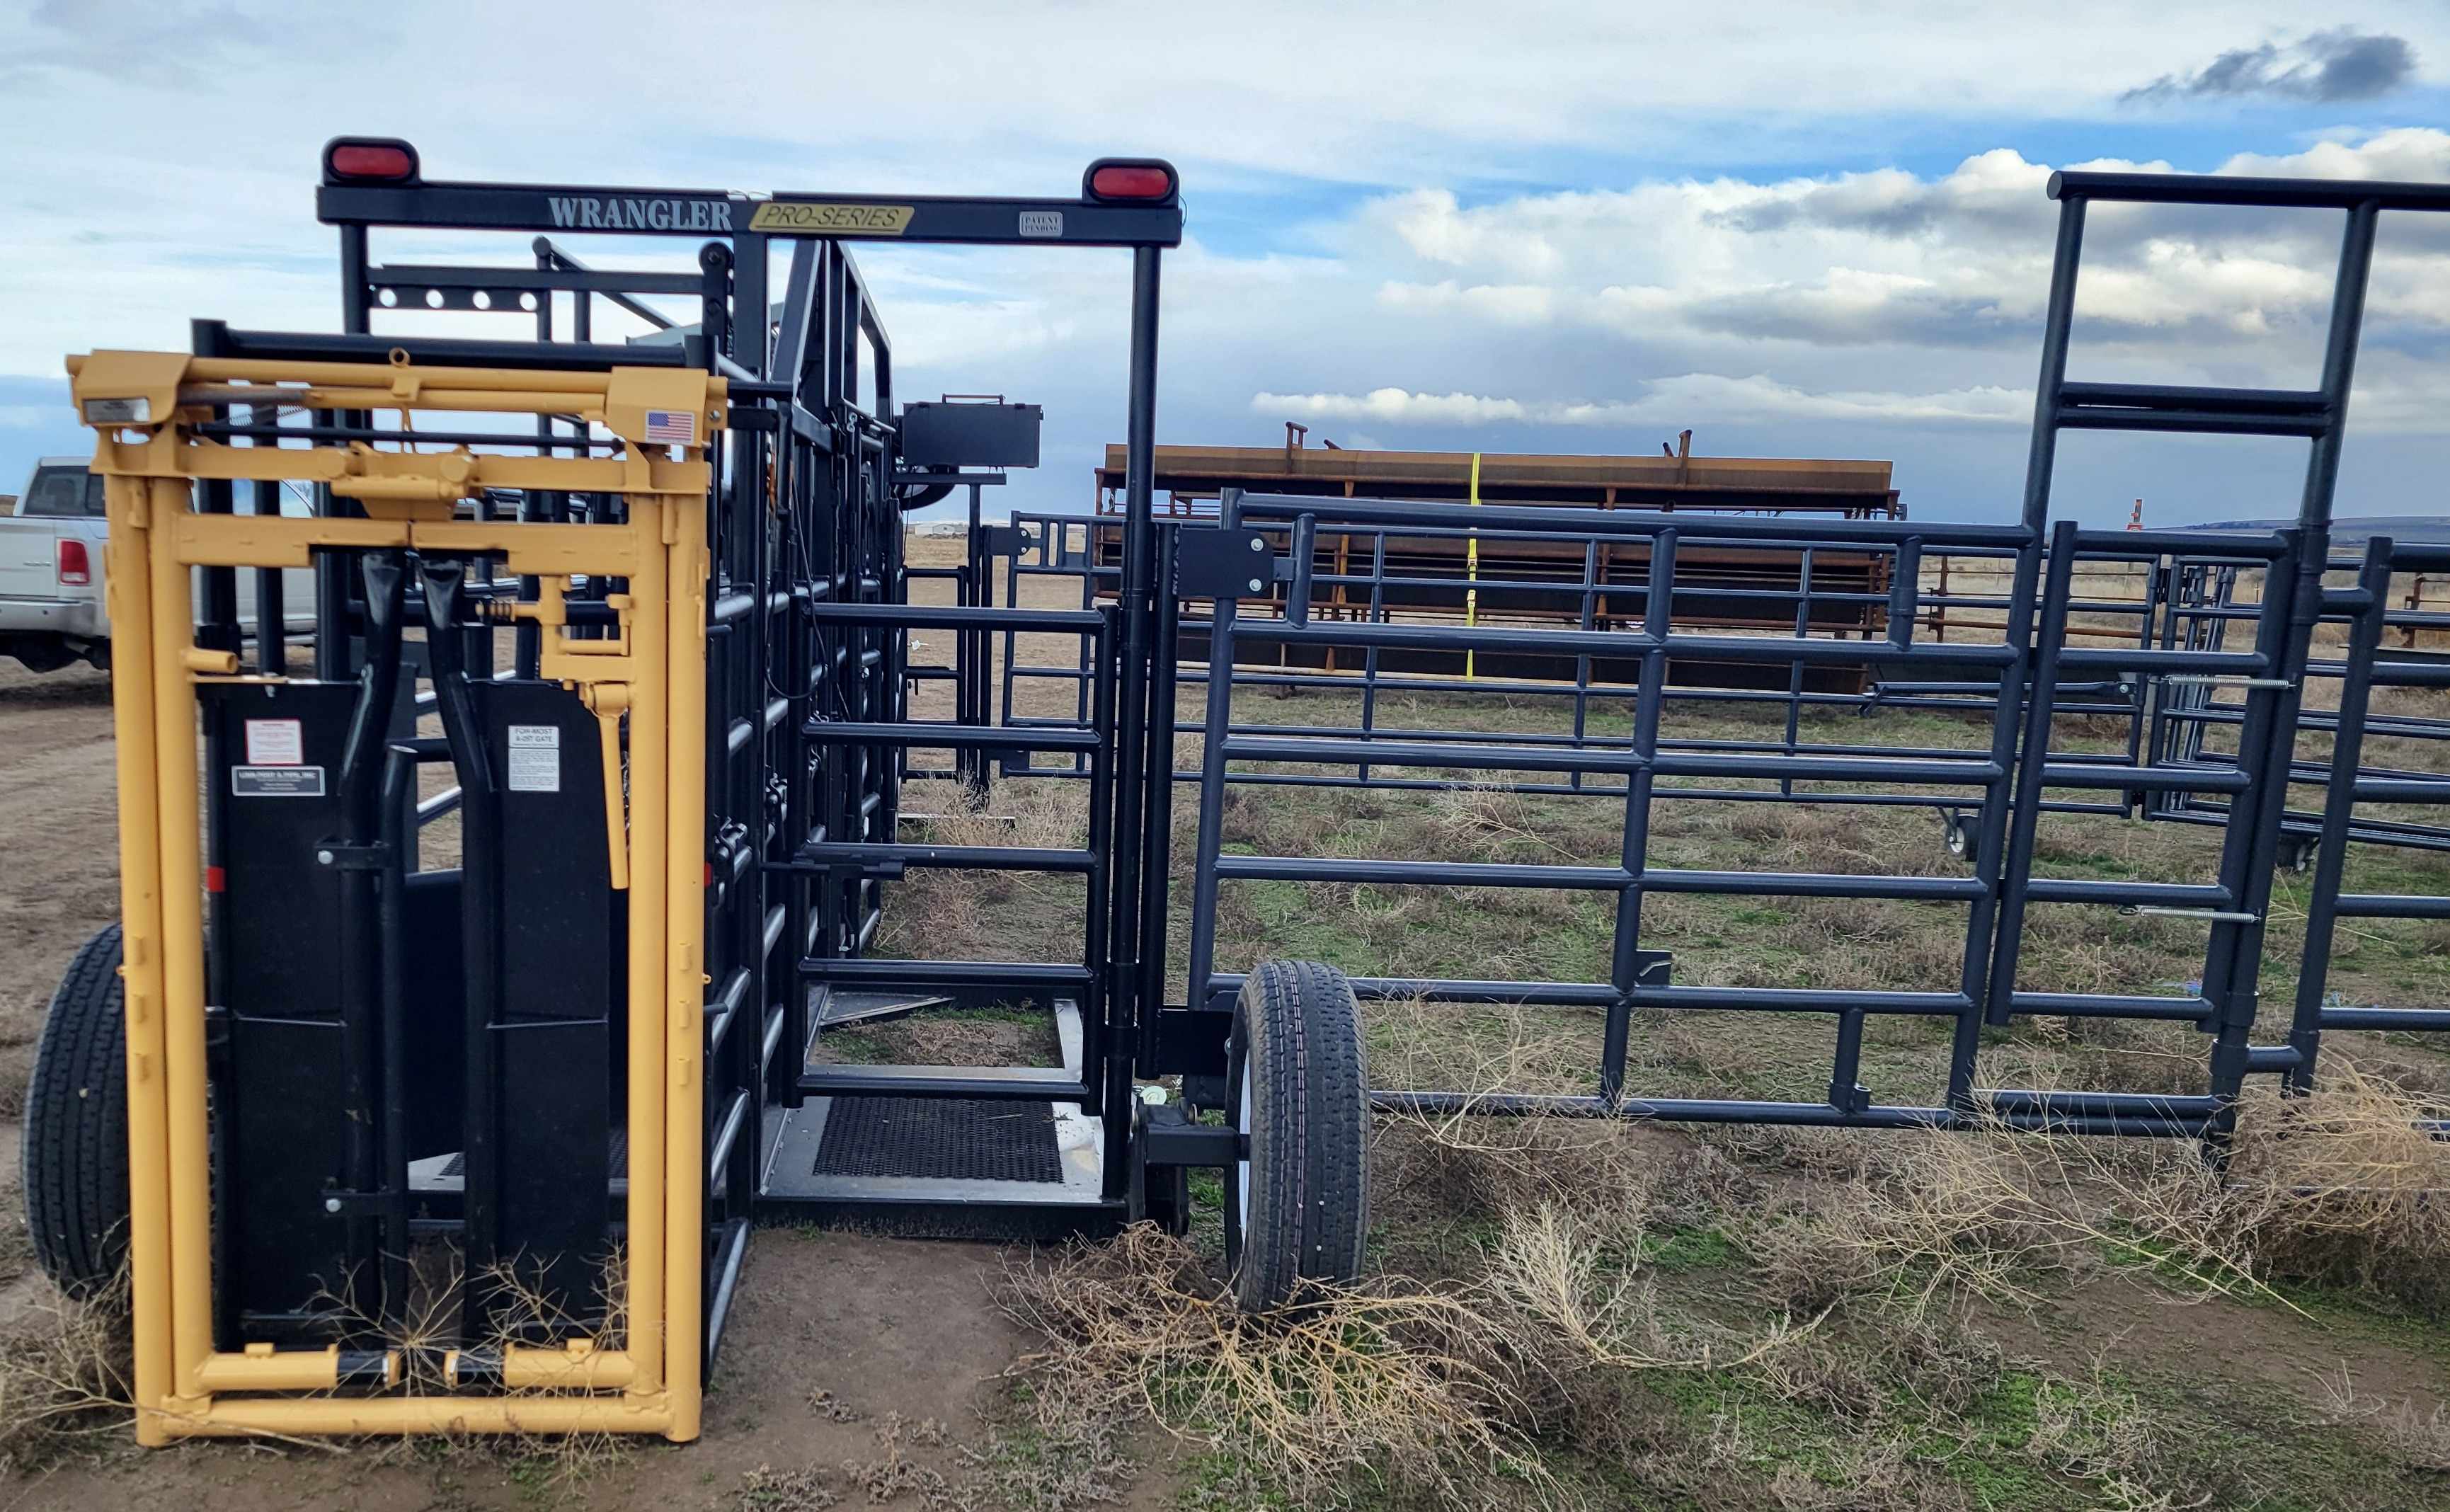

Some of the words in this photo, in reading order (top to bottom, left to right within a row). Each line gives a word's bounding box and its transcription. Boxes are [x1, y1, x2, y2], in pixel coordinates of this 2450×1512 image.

[548, 197, 733, 231] WRANGLER
[762, 205, 900, 227] PRO-SERIES
[1025, 214, 1058, 224] PATENT
